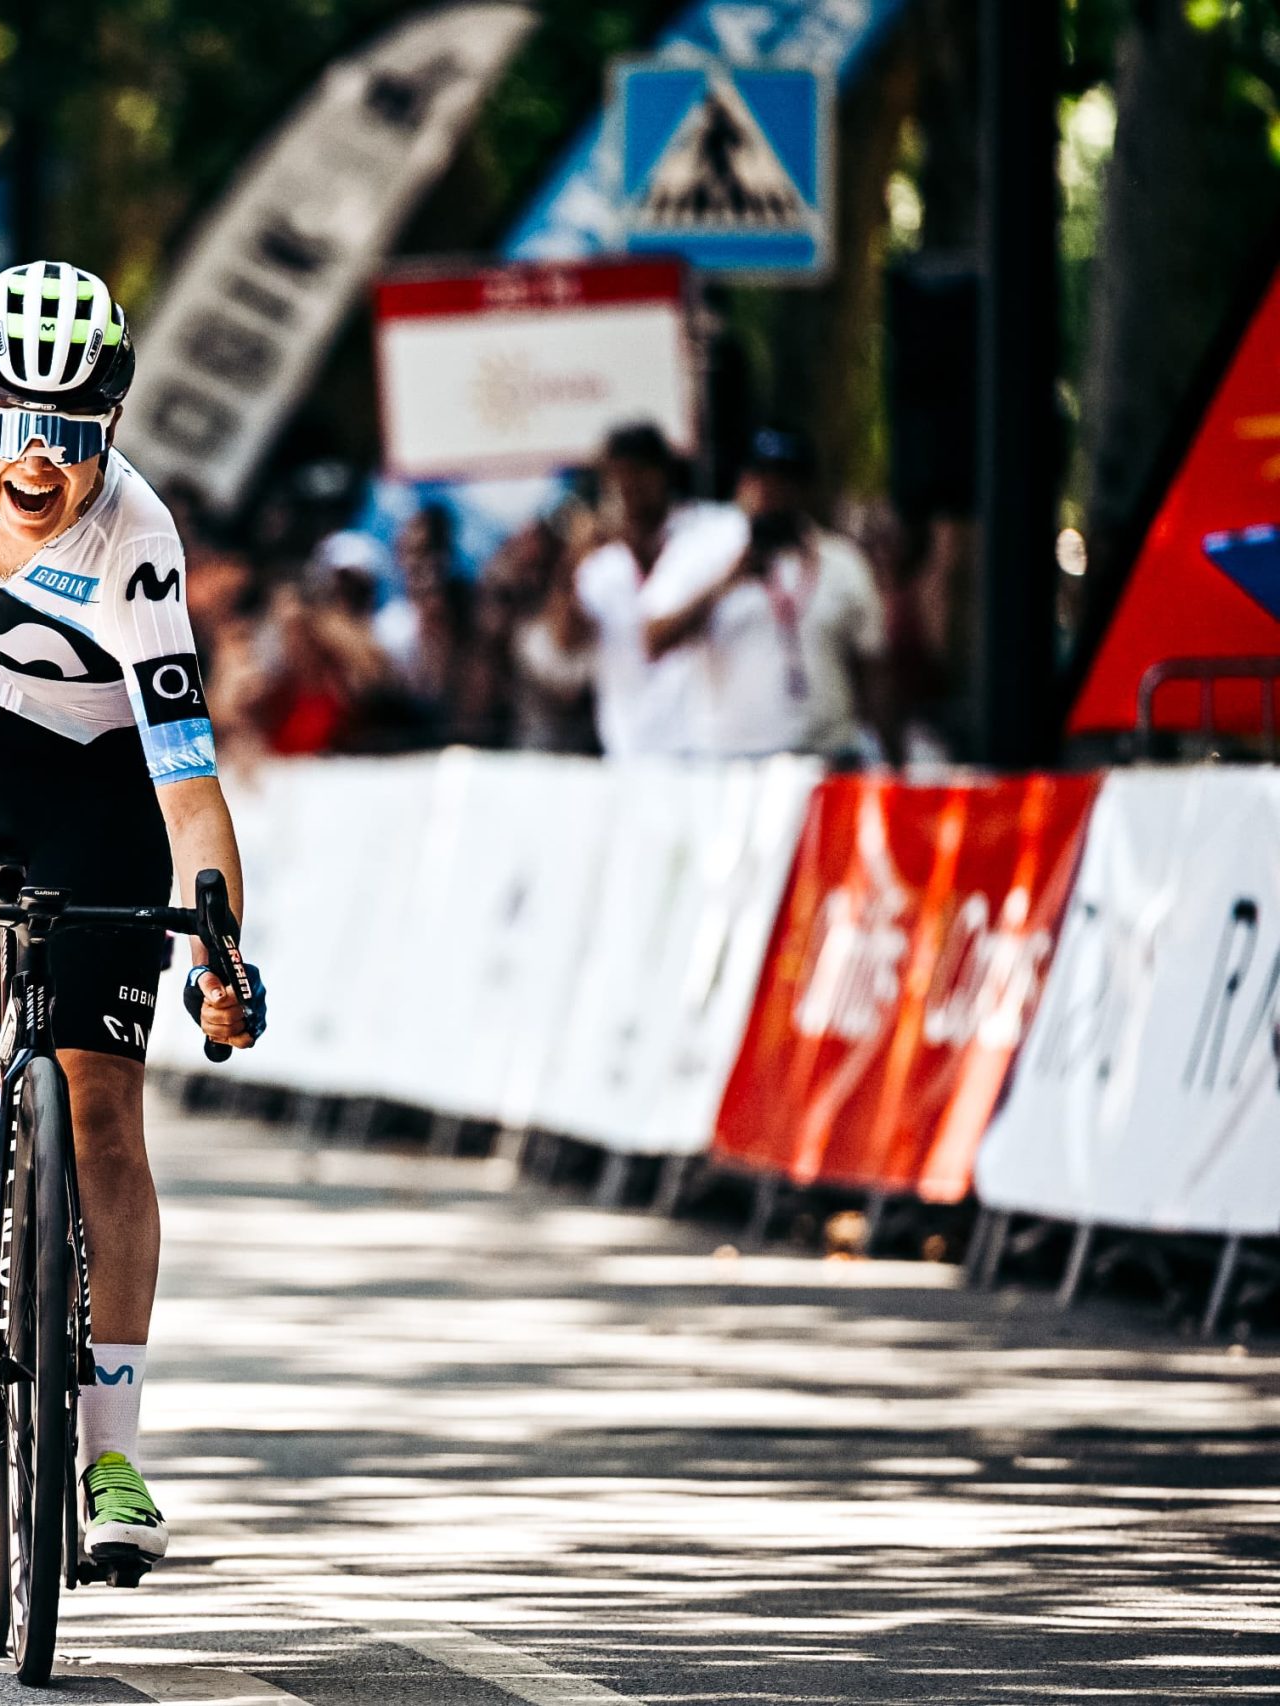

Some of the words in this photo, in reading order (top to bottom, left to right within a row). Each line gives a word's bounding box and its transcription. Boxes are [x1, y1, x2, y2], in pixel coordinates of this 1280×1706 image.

[89, 332, 103, 361] ABUS
[34, 569, 87, 597] GOBIK
[222, 935, 252, 999] SRAM
[26, 984, 34, 1030] CANYON
[37, 985, 45, 1030] CANYON
